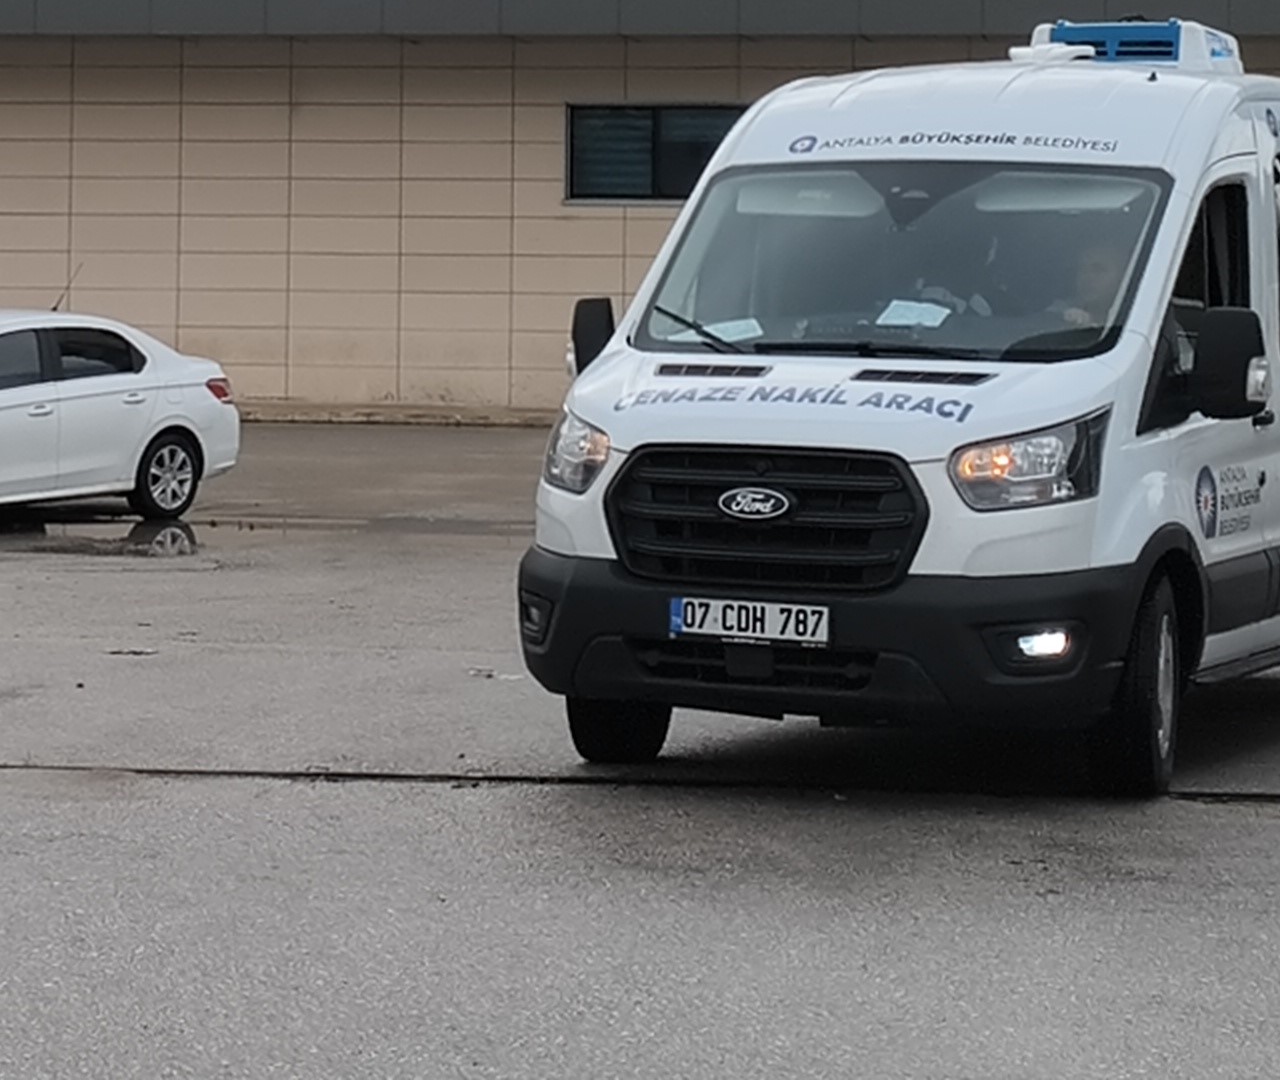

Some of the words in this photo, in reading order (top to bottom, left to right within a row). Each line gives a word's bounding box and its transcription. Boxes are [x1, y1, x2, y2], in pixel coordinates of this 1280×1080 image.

[819, 135, 893, 151] ANTALYA
[747, 383, 848, 406] NAKİL
[856, 390, 975, 423] ARACI
[730, 491, 776, 514] Ford
[682, 600, 711, 630] 07
[721, 603, 766, 635] CDH
[779, 606, 825, 638] 787
